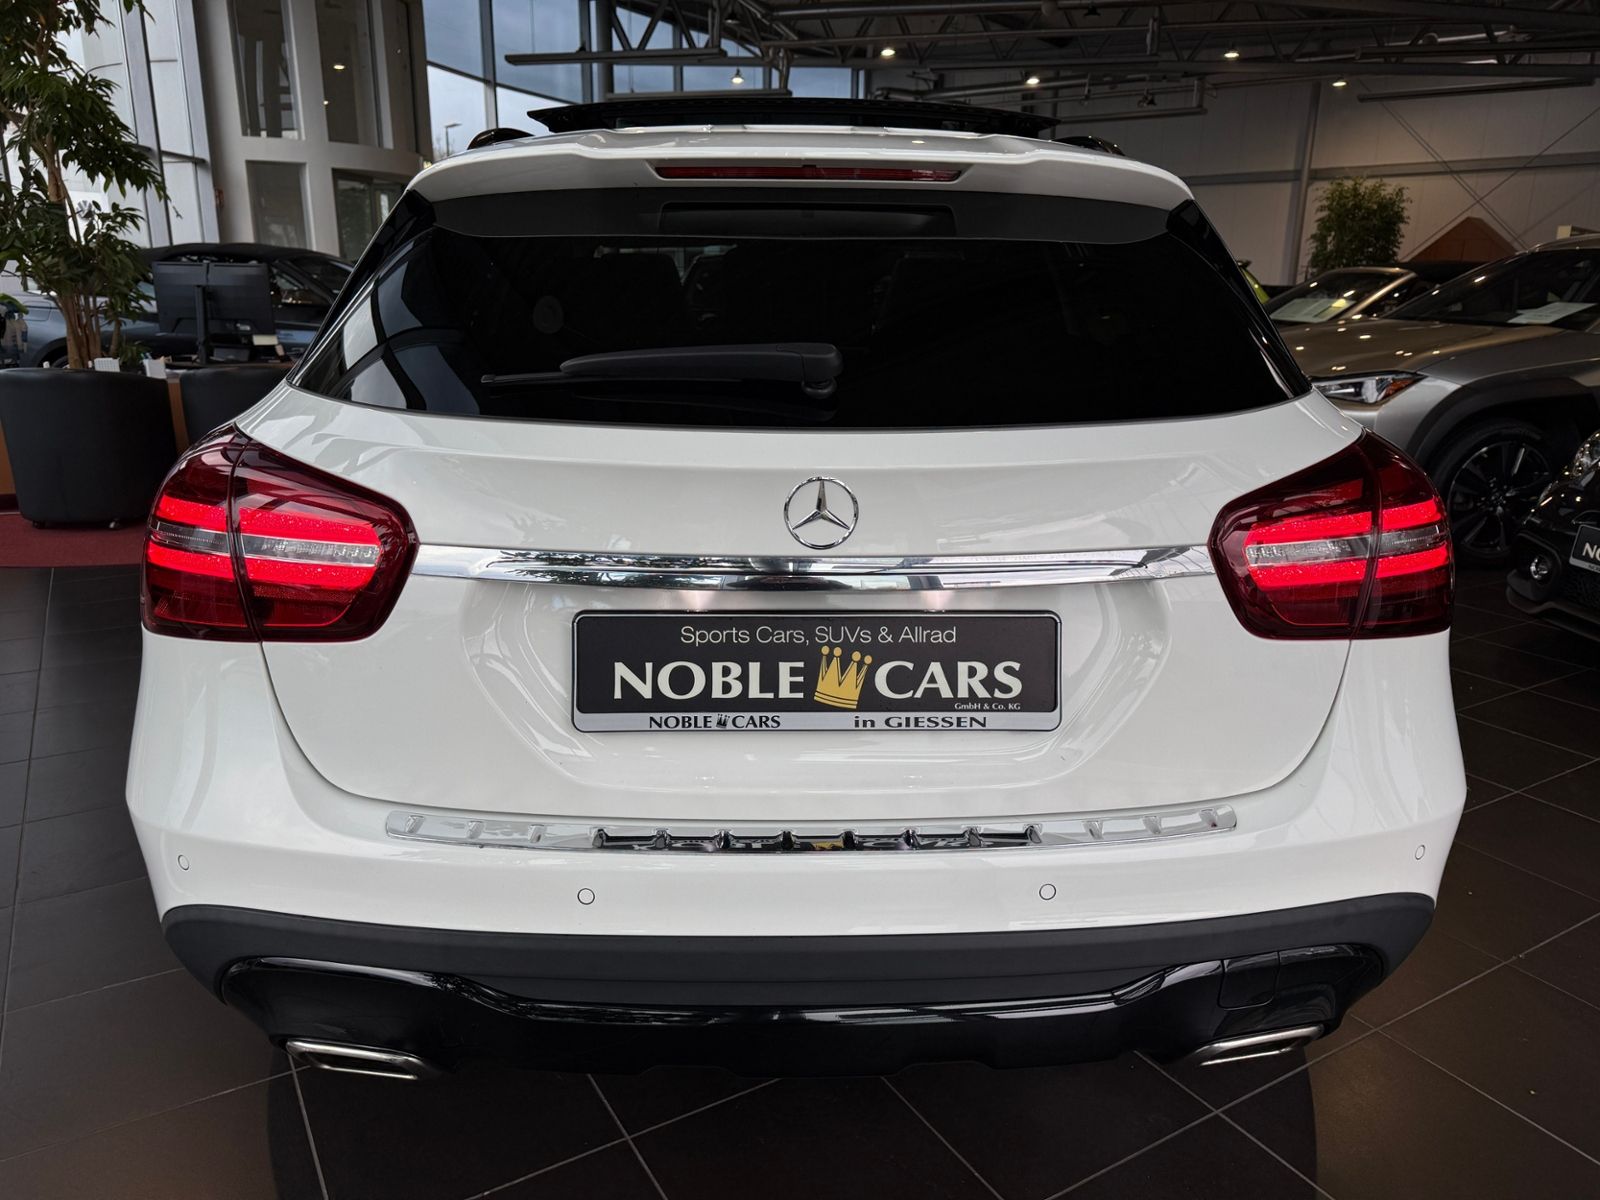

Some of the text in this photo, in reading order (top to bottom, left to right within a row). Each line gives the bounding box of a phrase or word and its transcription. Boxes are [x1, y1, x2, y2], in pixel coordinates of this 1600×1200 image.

[680, 625, 957, 648] Sports Cars, SUVs & Allrad
[613, 660, 1023, 700] NOBLE CARS
[954, 702, 1021, 711] GmbH & Co. KG
[649, 715, 987, 729] NOBLE CARS in GIESSEN
